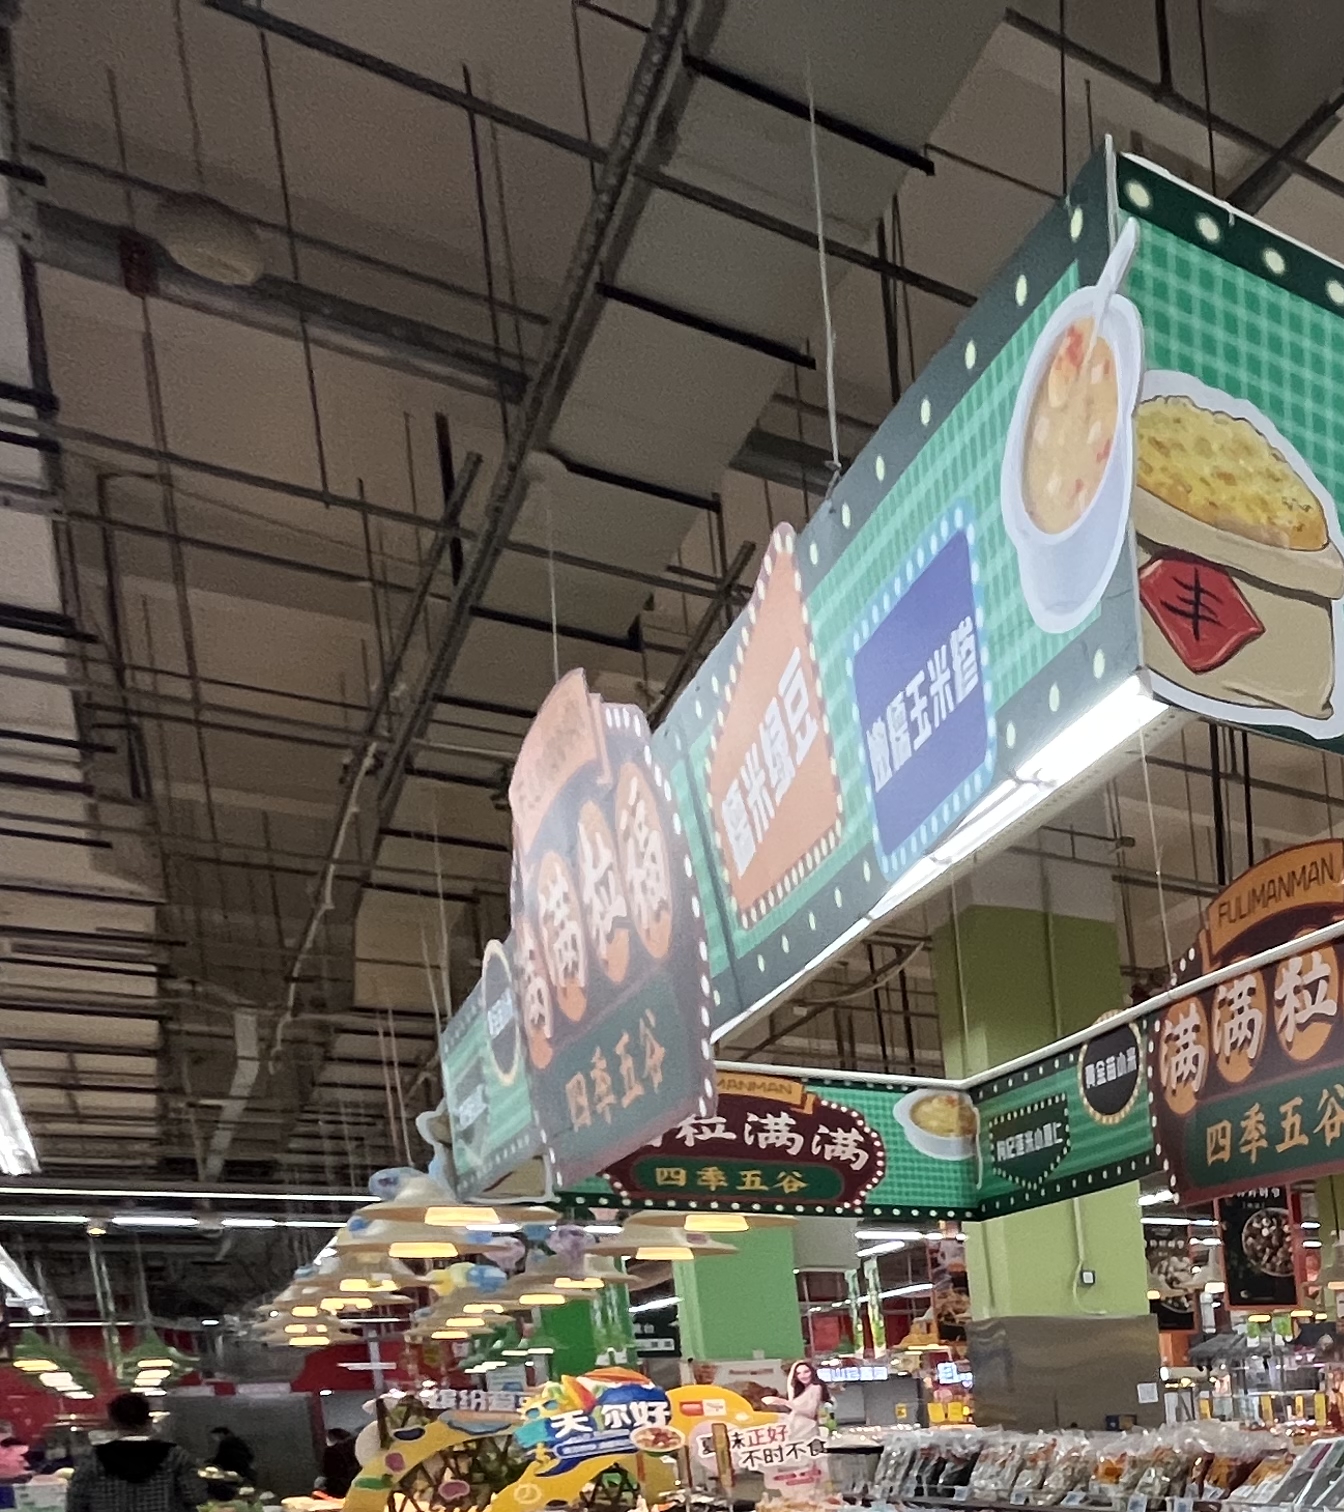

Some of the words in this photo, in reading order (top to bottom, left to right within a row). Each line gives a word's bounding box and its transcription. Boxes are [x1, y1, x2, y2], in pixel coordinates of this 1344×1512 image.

[1216, 850, 1338, 930] FULIMANMAN
[648, 1112, 873, 1171] 粒满满
[654, 1166, 810, 1196] 四季五谷
